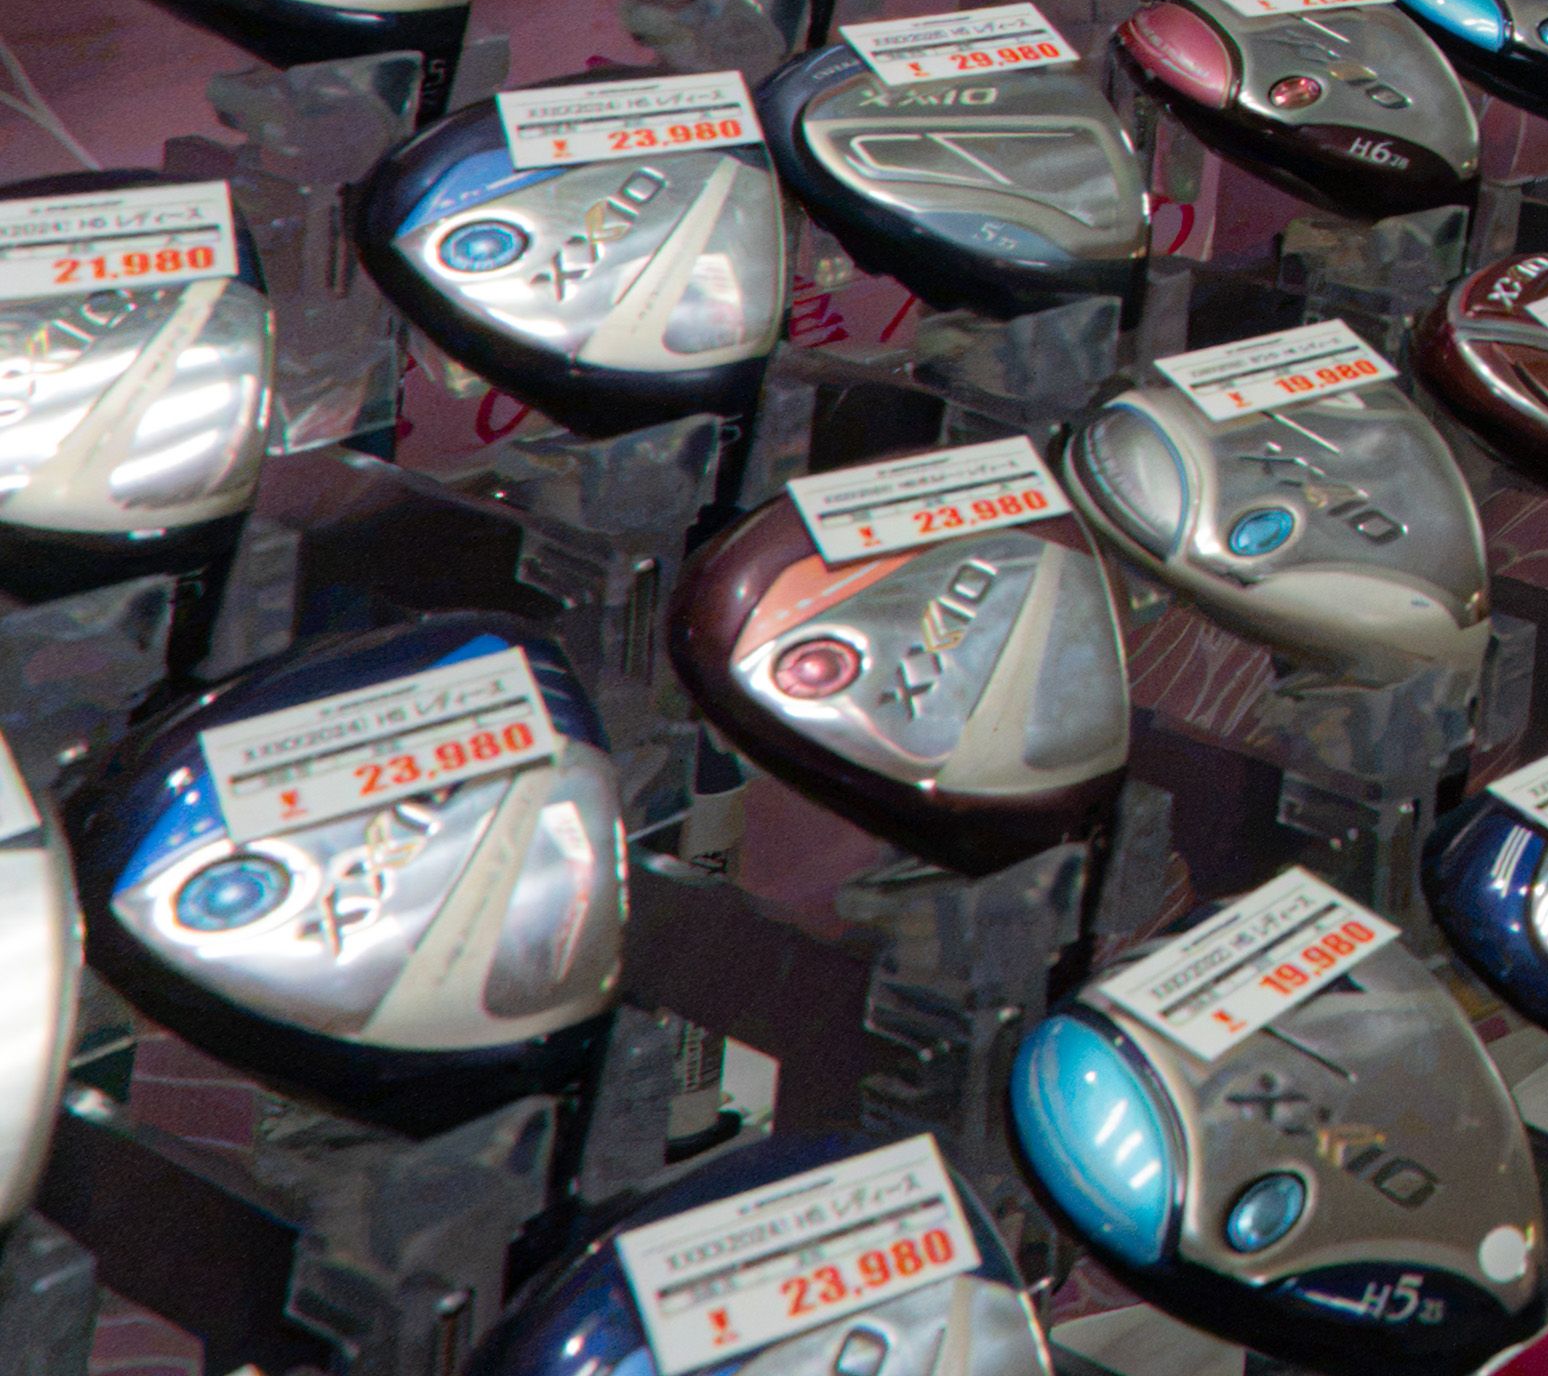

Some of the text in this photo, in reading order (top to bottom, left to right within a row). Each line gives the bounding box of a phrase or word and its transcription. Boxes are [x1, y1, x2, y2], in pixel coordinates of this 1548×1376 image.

[950, 42, 1061, 72] 29,980
[610, 119, 744, 152] 23,980
[54, 246, 214, 285] 21,980
[1274, 357, 1379, 395] 19,980
[912, 489, 1050, 536] 23,980
[353, 722, 537, 797] 23,980
[1257, 920, 1377, 998] 19,980
[781, 1226, 955, 1318] 23,980
